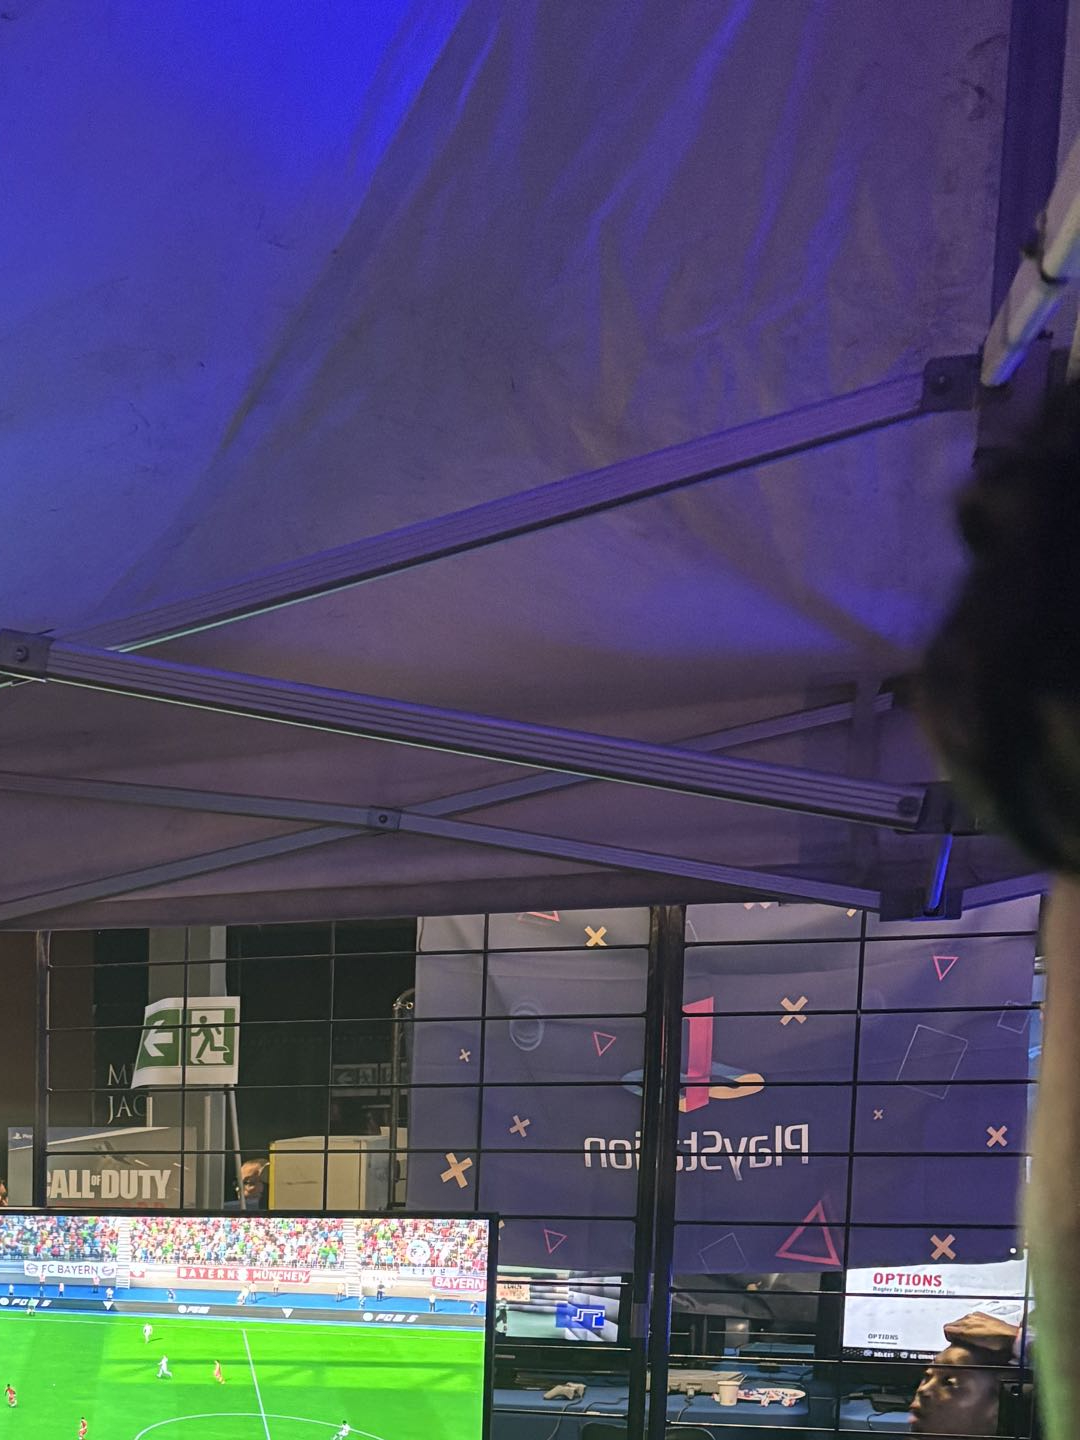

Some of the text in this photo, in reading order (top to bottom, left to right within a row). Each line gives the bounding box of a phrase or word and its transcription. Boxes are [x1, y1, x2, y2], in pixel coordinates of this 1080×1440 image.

[47, 1169, 95, 1199] ALL
[101, 1169, 172, 1199] DUTY
[41, 1264, 99, 1275] FC BAYERN
[179, 1268, 237, 1281] BAYERN
[434, 1276, 486, 1291] BAYERN
[873, 1272, 942, 1288] OPTIONS
[867, 1333, 899, 1341] OPTIONS
